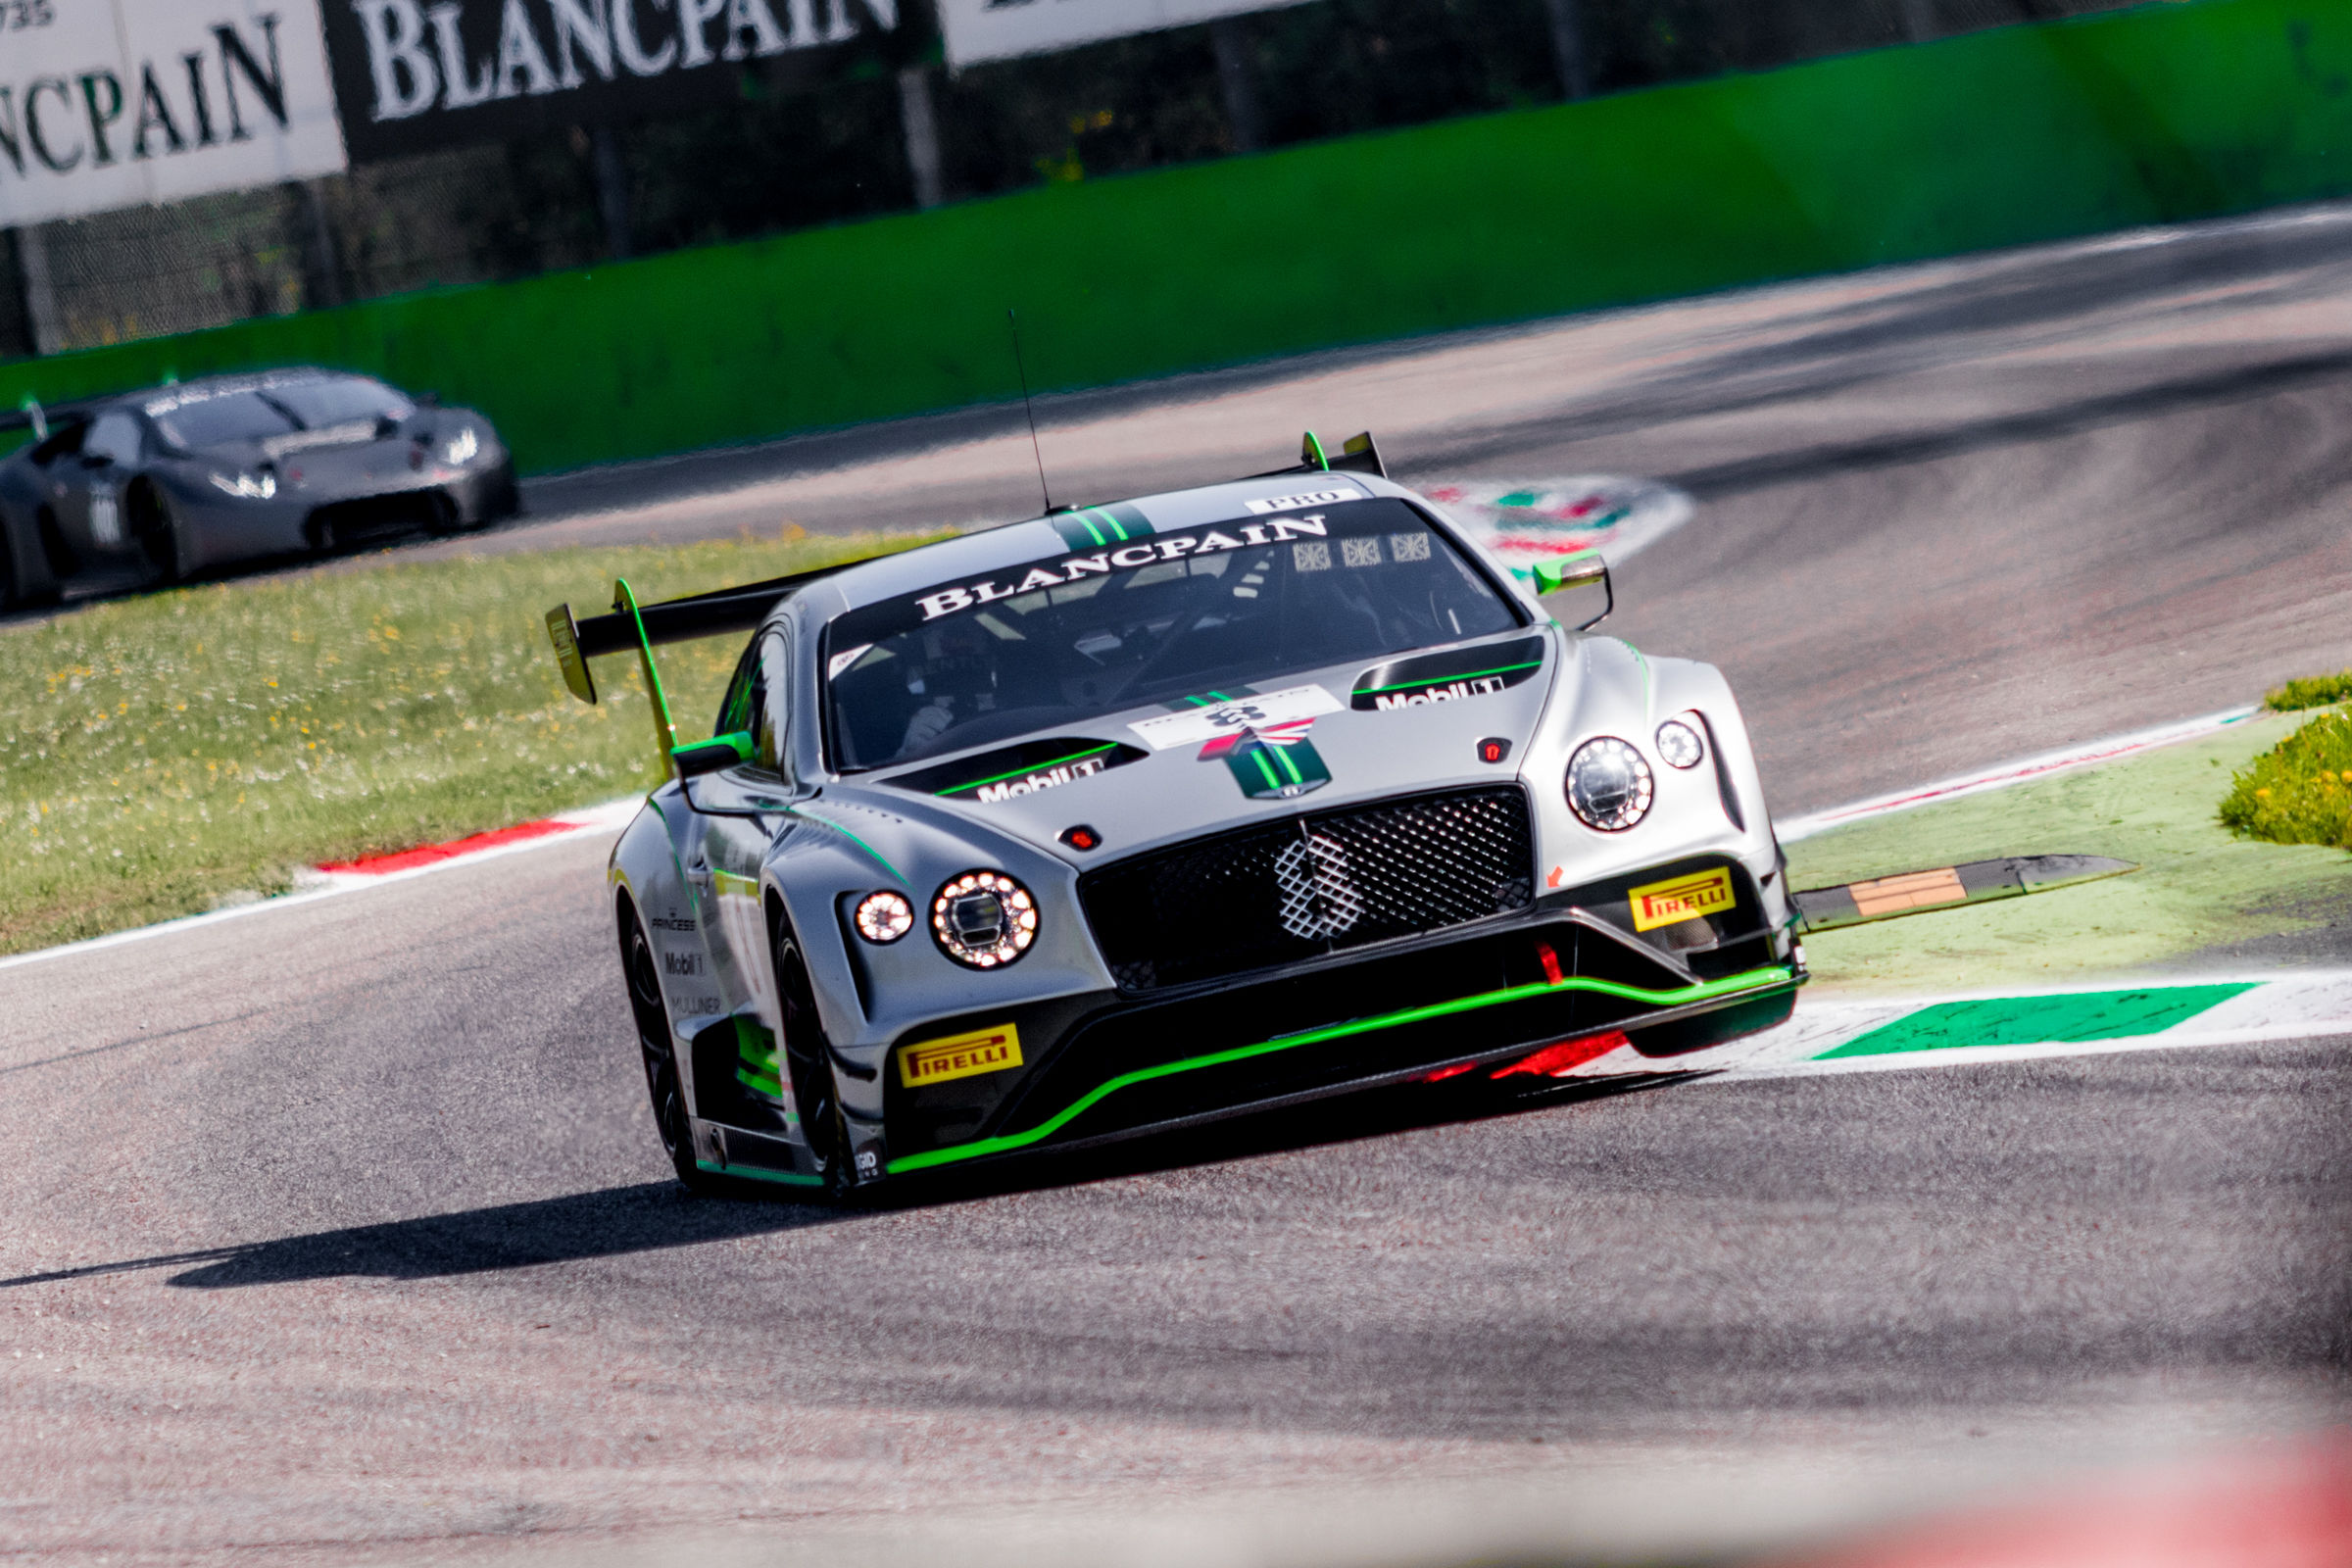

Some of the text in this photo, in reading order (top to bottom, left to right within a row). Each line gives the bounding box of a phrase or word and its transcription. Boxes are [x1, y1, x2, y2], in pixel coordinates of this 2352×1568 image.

[1266, 492, 1340, 509] PRO
[915, 514, 1328, 621] BLANCPAIN
[1375, 682, 1469, 711] Mobil
[977, 766, 1072, 804] Mobil
[1641, 876, 1727, 920] PIRELLI
[906, 1035, 1008, 1079] PIRELLI
